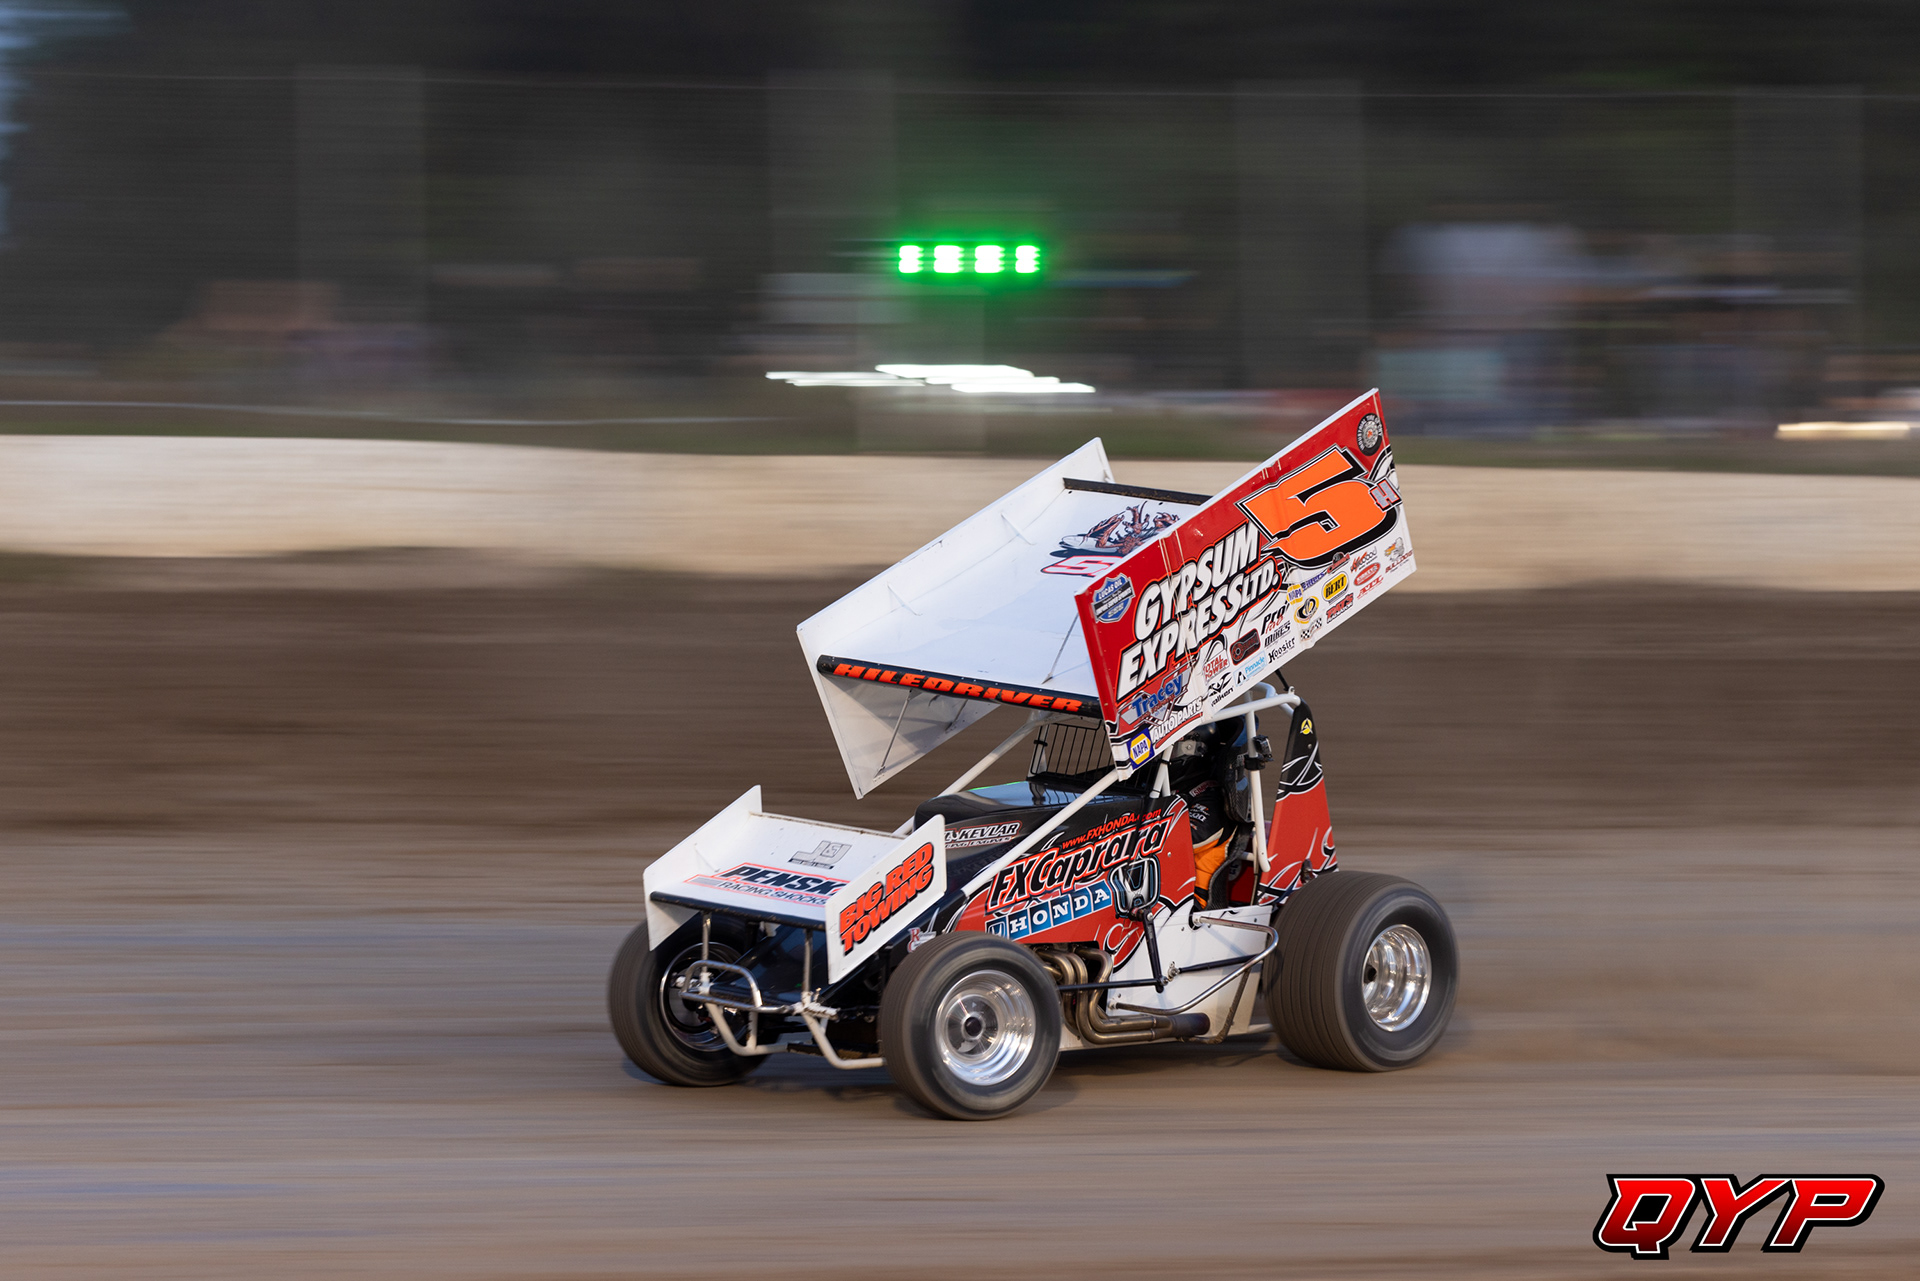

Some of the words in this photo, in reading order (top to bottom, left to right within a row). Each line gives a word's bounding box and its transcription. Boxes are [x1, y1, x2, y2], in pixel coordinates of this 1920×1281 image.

[1239, 446, 1397, 566] 5
[1370, 479, 1400, 510] H
[1098, 584, 1114, 600] LUCAS
[1135, 526, 1259, 640] GYPSUM
[1325, 576, 1346, 598] BERT
[1118, 578, 1242, 698] EXPRESS
[1238, 562, 1279, 608] LTD.
[1132, 674, 1183, 718] Tracey
[1152, 716, 1177, 743] AUTO
[1176, 697, 1204, 723] PARTS
[1132, 739, 1149, 759] NAPA
[959, 823, 1019, 841] KEVLAR
[718, 881, 770, 896] RACING
[770, 889, 826, 905] SHOCKS
[720, 865, 847, 896] PENSK
[840, 881, 884, 934] BIG
[885, 842, 934, 897] RED
[841, 863, 934, 956] TOWING
[1009, 888, 1109, 933] HONDA
